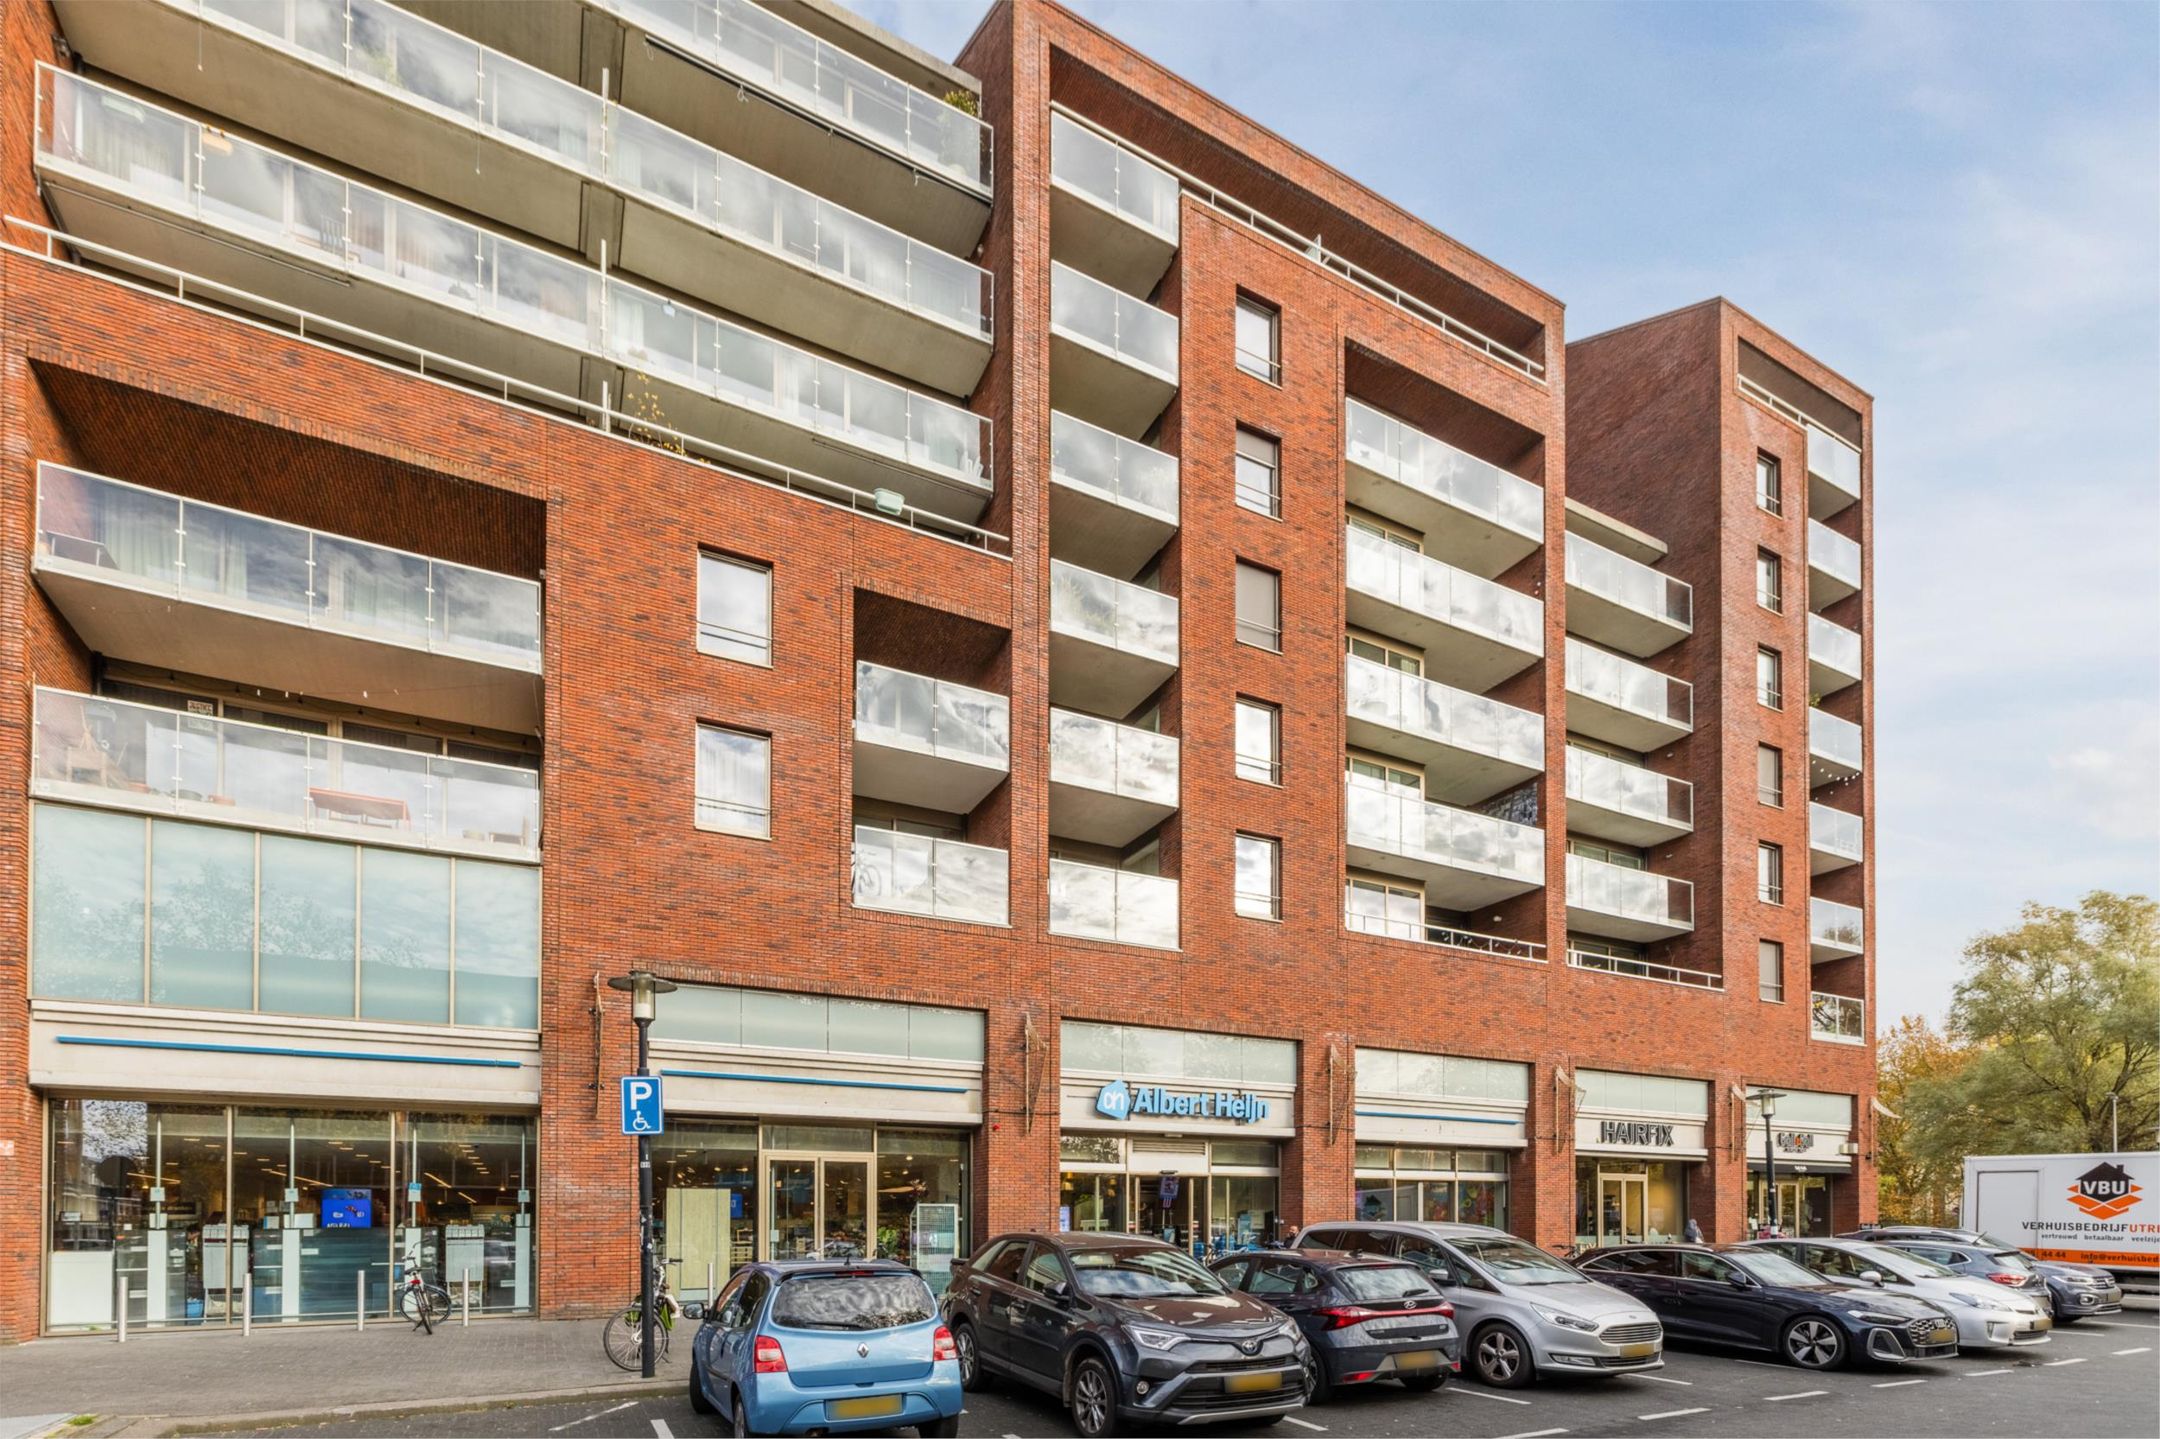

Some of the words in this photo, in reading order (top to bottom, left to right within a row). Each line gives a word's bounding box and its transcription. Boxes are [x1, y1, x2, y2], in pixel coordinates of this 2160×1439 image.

[630, 1081, 653, 1111] P
[1133, 1087, 1209, 1116] Albert
[1214, 1092, 1270, 1125] Heijn
[1600, 1121, 1674, 1147] HAIRFIX
[2083, 1180, 2126, 1195] VBU
[2041, 1232, 2078, 1240] vertrouwd
[2084, 1233, 2124, 1242] betaalbaar
